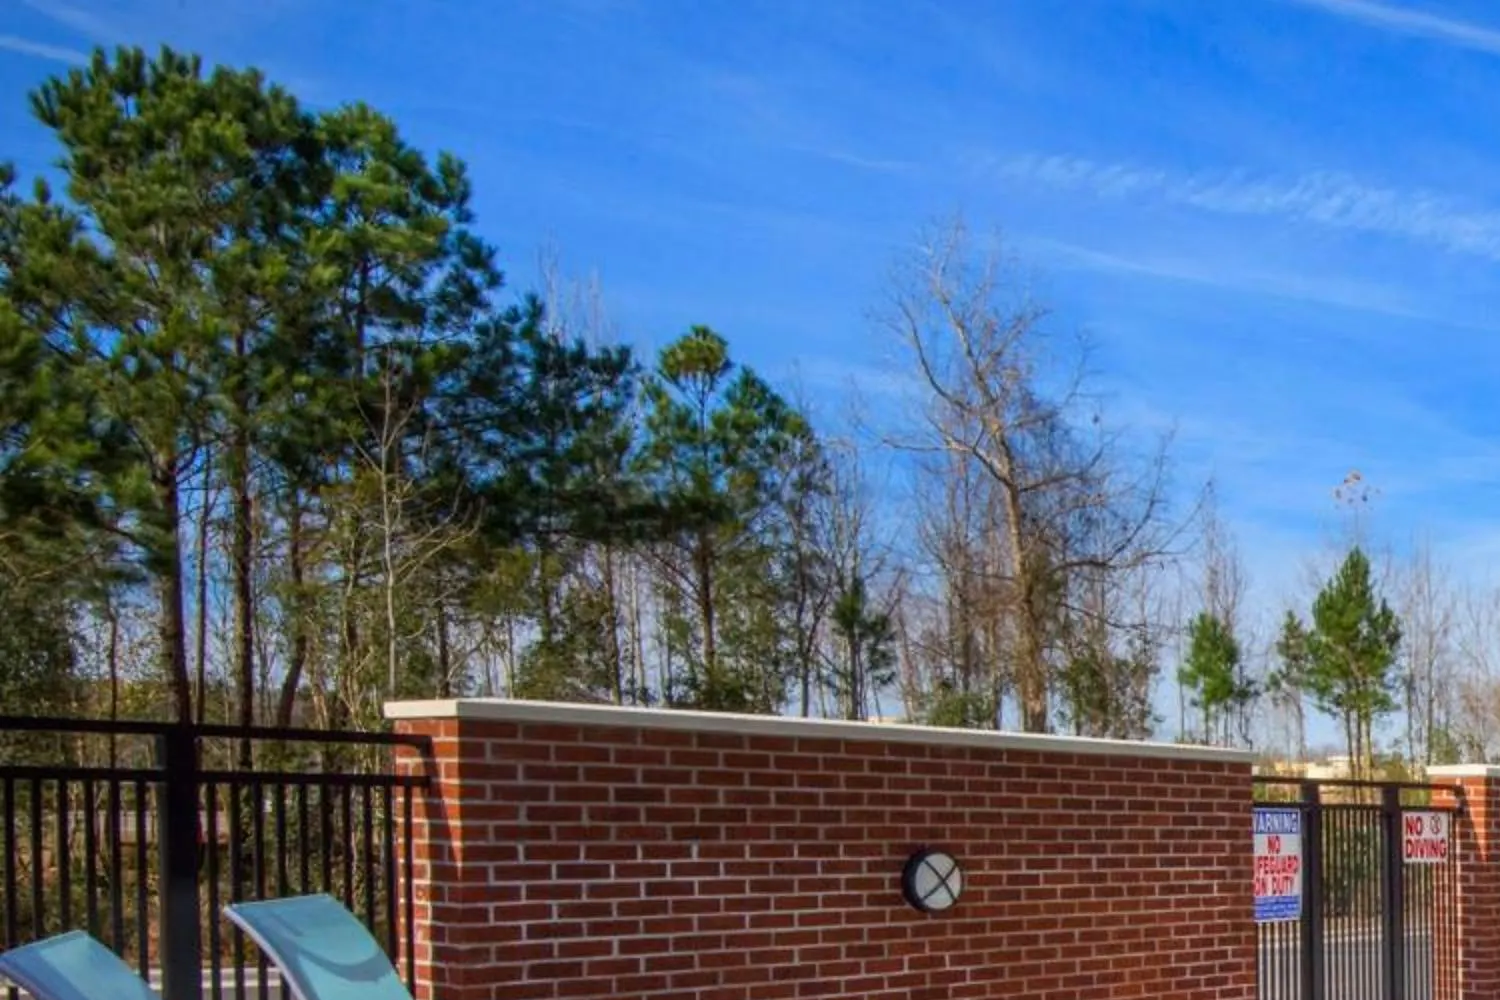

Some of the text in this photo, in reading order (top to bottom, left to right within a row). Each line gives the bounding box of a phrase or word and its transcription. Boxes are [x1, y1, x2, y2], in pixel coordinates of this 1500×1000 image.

[1253, 812, 1297, 832] ARNING
[1405, 815, 1423, 836] NO
[1267, 835, 1281, 854] NO
[1405, 838, 1447, 858] DIVING
[1254, 855, 1299, 875] IFEGUARD
[1272, 875, 1295, 895] DUTY
